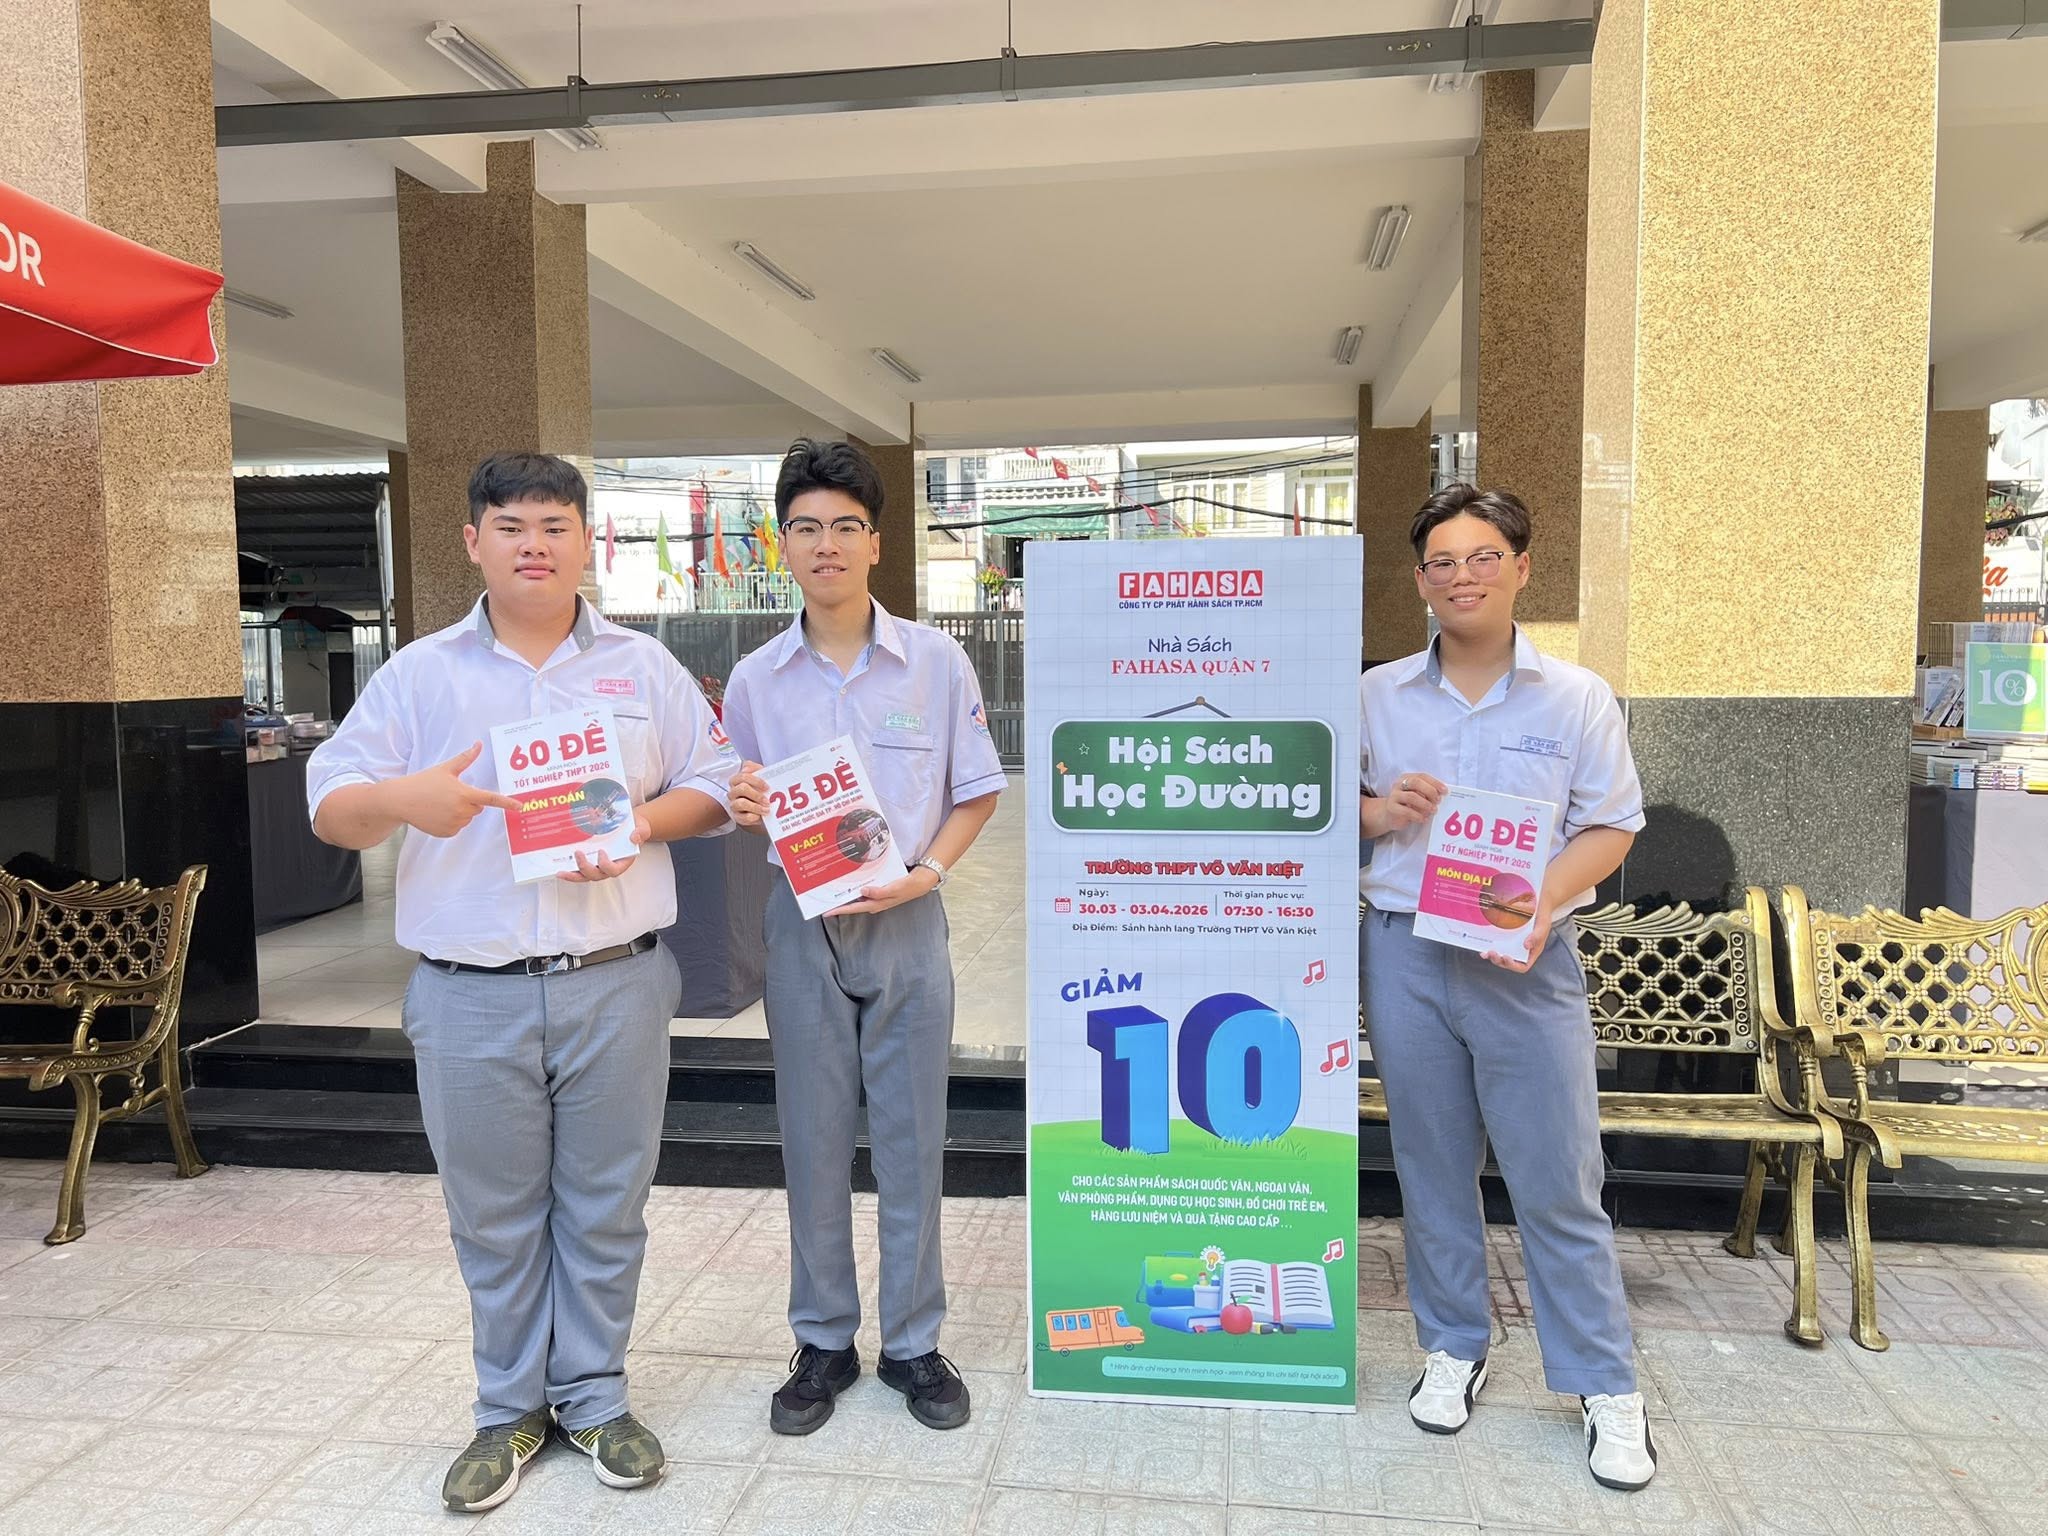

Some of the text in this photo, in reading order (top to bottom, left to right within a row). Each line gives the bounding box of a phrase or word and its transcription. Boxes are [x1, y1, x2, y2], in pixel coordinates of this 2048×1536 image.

[1120, 571, 1262, 598] FAHASA
[1119, 598, 1263, 609] CÔNG TY CP PHÁT HÀNH SÁCH TP.HCM
[1148, 635, 1232, 653] Nhà Sách
[1111, 657, 1271, 676] FAHASA QUẬN 7
[509, 718, 607, 771] 60 ĐỀ
[1108, 735, 1273, 772] Hội Sách
[514, 760, 610, 789] TỐT NGHIỆP THPT 2026
[550, 790, 586, 806] TOÁN
[769, 782, 810, 819] 25
[812, 756, 859, 801] ĐỀ
[1062, 774, 1321, 819] Học Đường
[1444, 810, 1538, 852] 60 ĐỀ
[790, 832, 825, 854] V-ACT
[1441, 843, 1532, 870] TỐT NGHIỆP THPT 2026
[1085, 859, 1304, 880] TRƯỜNG THPT VÕ VĂN KIỆT
[1436, 866, 1493, 887] MÔN ĐỊA LÍ
[1078, 887, 1109, 898] Ngày:
[1223, 890, 1243, 898] Thời
[1244, 891, 1264, 900] gian
[1078, 903, 1117, 914] 30.03
[1129, 904, 1209, 915] 03.04.2026
[1224, 906, 1264, 916] 07:30
[1276, 907, 1314, 917] 16:30
[1072, 923, 1317, 935] Địa Điểm: Sảnh hành lang Trường THPT Võ Văn Kiệt
[1060, 968, 1143, 1002] GIẢM
[1087, 992, 1301, 1155] 10
[1072, 1175, 1092, 1187] CHO
[1094, 1173, 1115, 1187] CÁC
[1116, 1173, 1138, 1188] SẢN
[1139, 1174, 1170, 1189] PHẨM
[1171, 1177, 1199, 1190] SÁCH
[1200, 1177, 1228, 1191] QUỐC
[1255, 1181, 1287, 1195] NGOẠI
[1057, 1190, 1079, 1203] VĂN
[1080, 1191, 1115, 1204] PHÒNG
[1150, 1194, 1178, 1208] DỤNG
[1179, 1195, 1193, 1209] CỤ
[1195, 1196, 1216, 1209] HỌC
[1262, 1198, 1286, 1211] CHƠI
[1287, 1197, 1308, 1211] TRẺ
[1091, 1208, 1120, 1222] HÀNG
[1121, 1210, 1141, 1223] LƯU
[1142, 1209, 1168, 1225] NIỆM
[1169, 1210, 1184, 1224] VÀ
[1185, 1211, 1207, 1225] QUÀ
[1208, 1212, 1235, 1228] TẶNG
[1236, 1214, 1257, 1227] CAO
